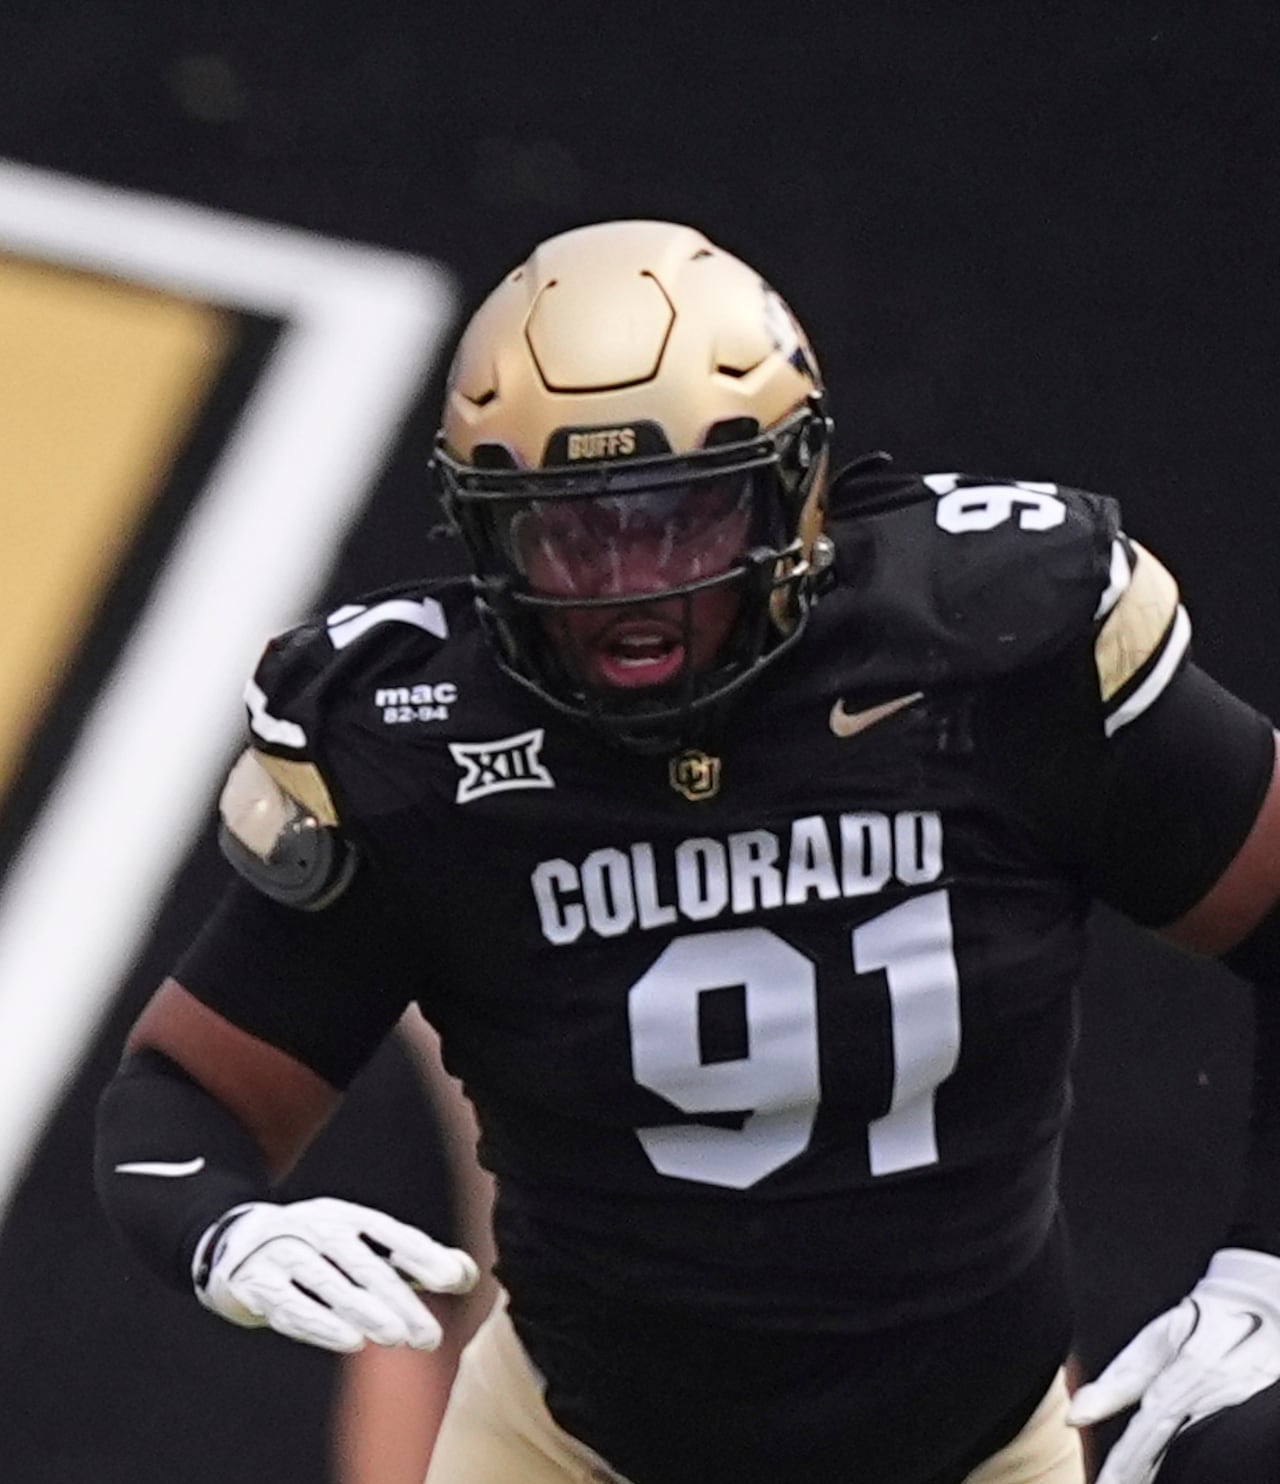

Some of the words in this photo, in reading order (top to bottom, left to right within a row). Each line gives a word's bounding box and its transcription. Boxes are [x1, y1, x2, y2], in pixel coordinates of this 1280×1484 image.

[567, 427, 637, 460] BUFFS
[374, 681, 459, 707] mac
[382, 704, 450, 725] 82-94
[530, 810, 944, 946] COLORADO
[626, 887, 963, 1191] 91
